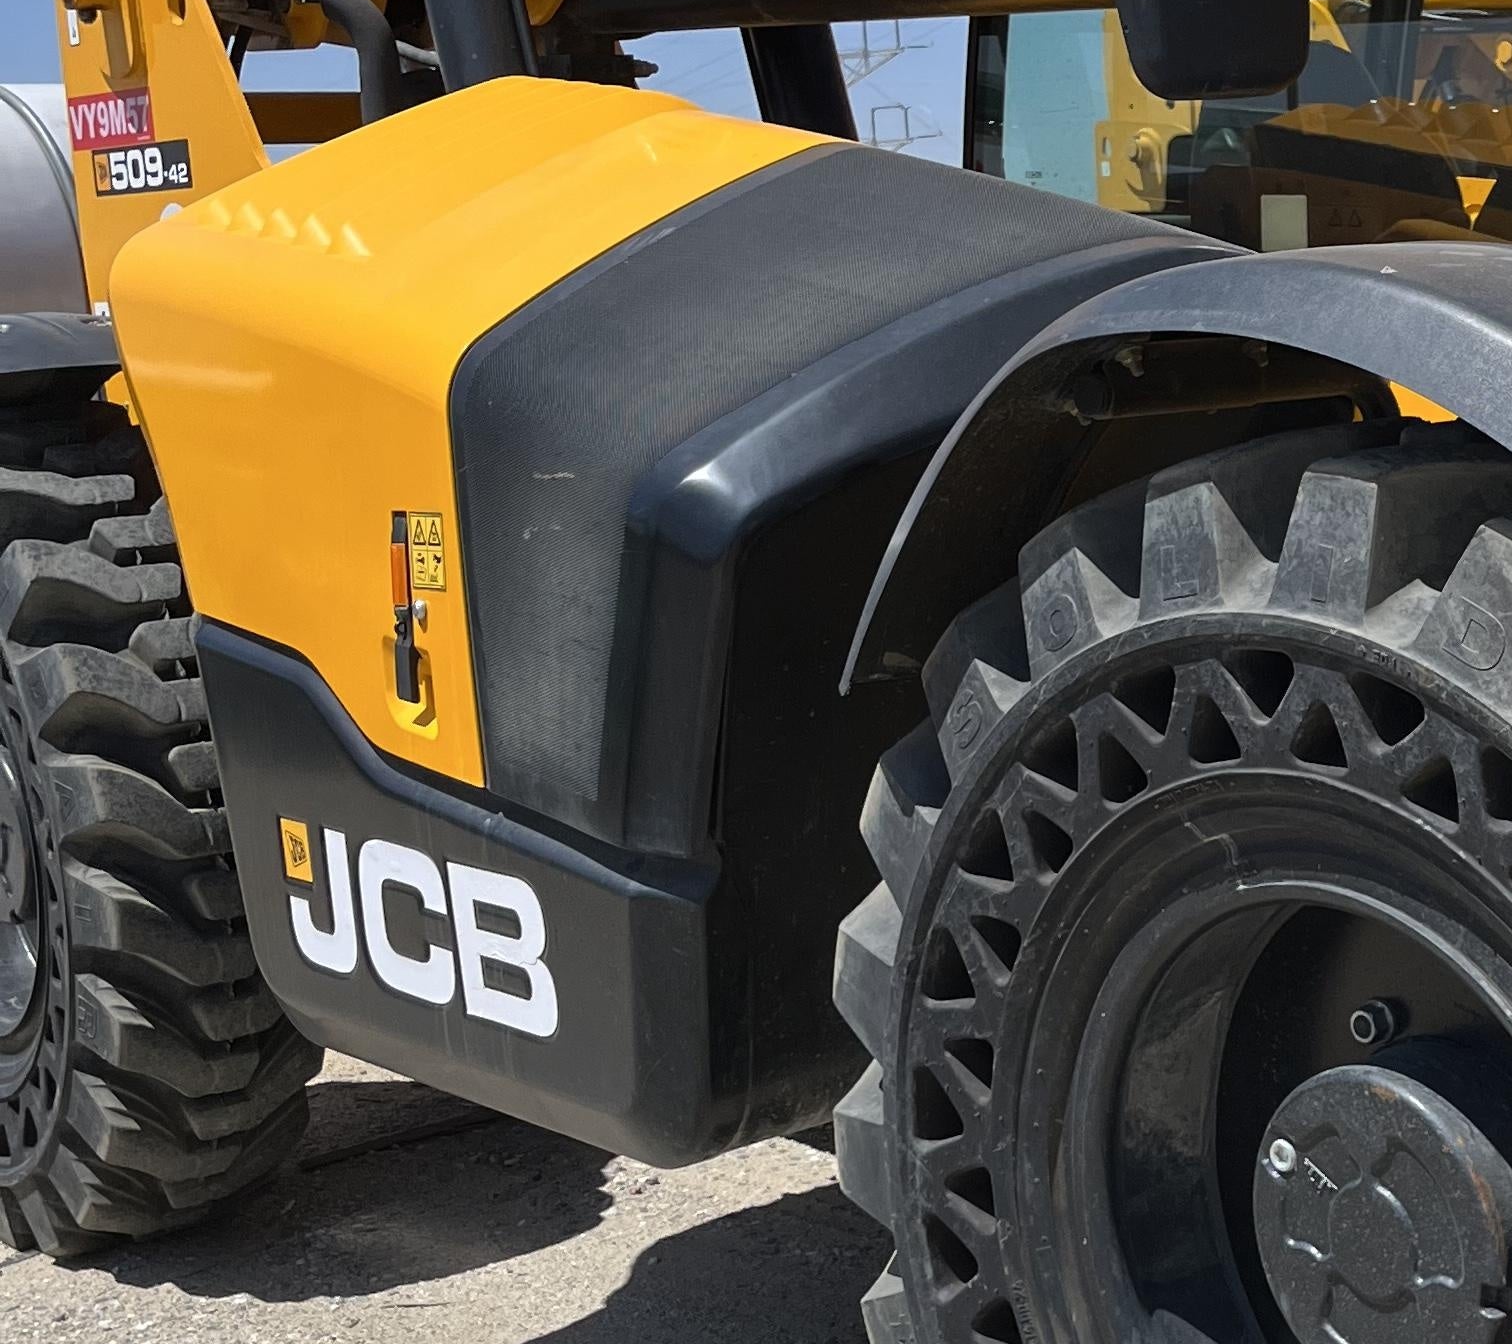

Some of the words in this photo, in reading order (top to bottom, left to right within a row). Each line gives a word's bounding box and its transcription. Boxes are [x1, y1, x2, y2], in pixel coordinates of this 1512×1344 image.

[69, 94, 149, 141] VY9M57
[108, 147, 189, 191] 509-42
[289, 827, 559, 1038] JCB
